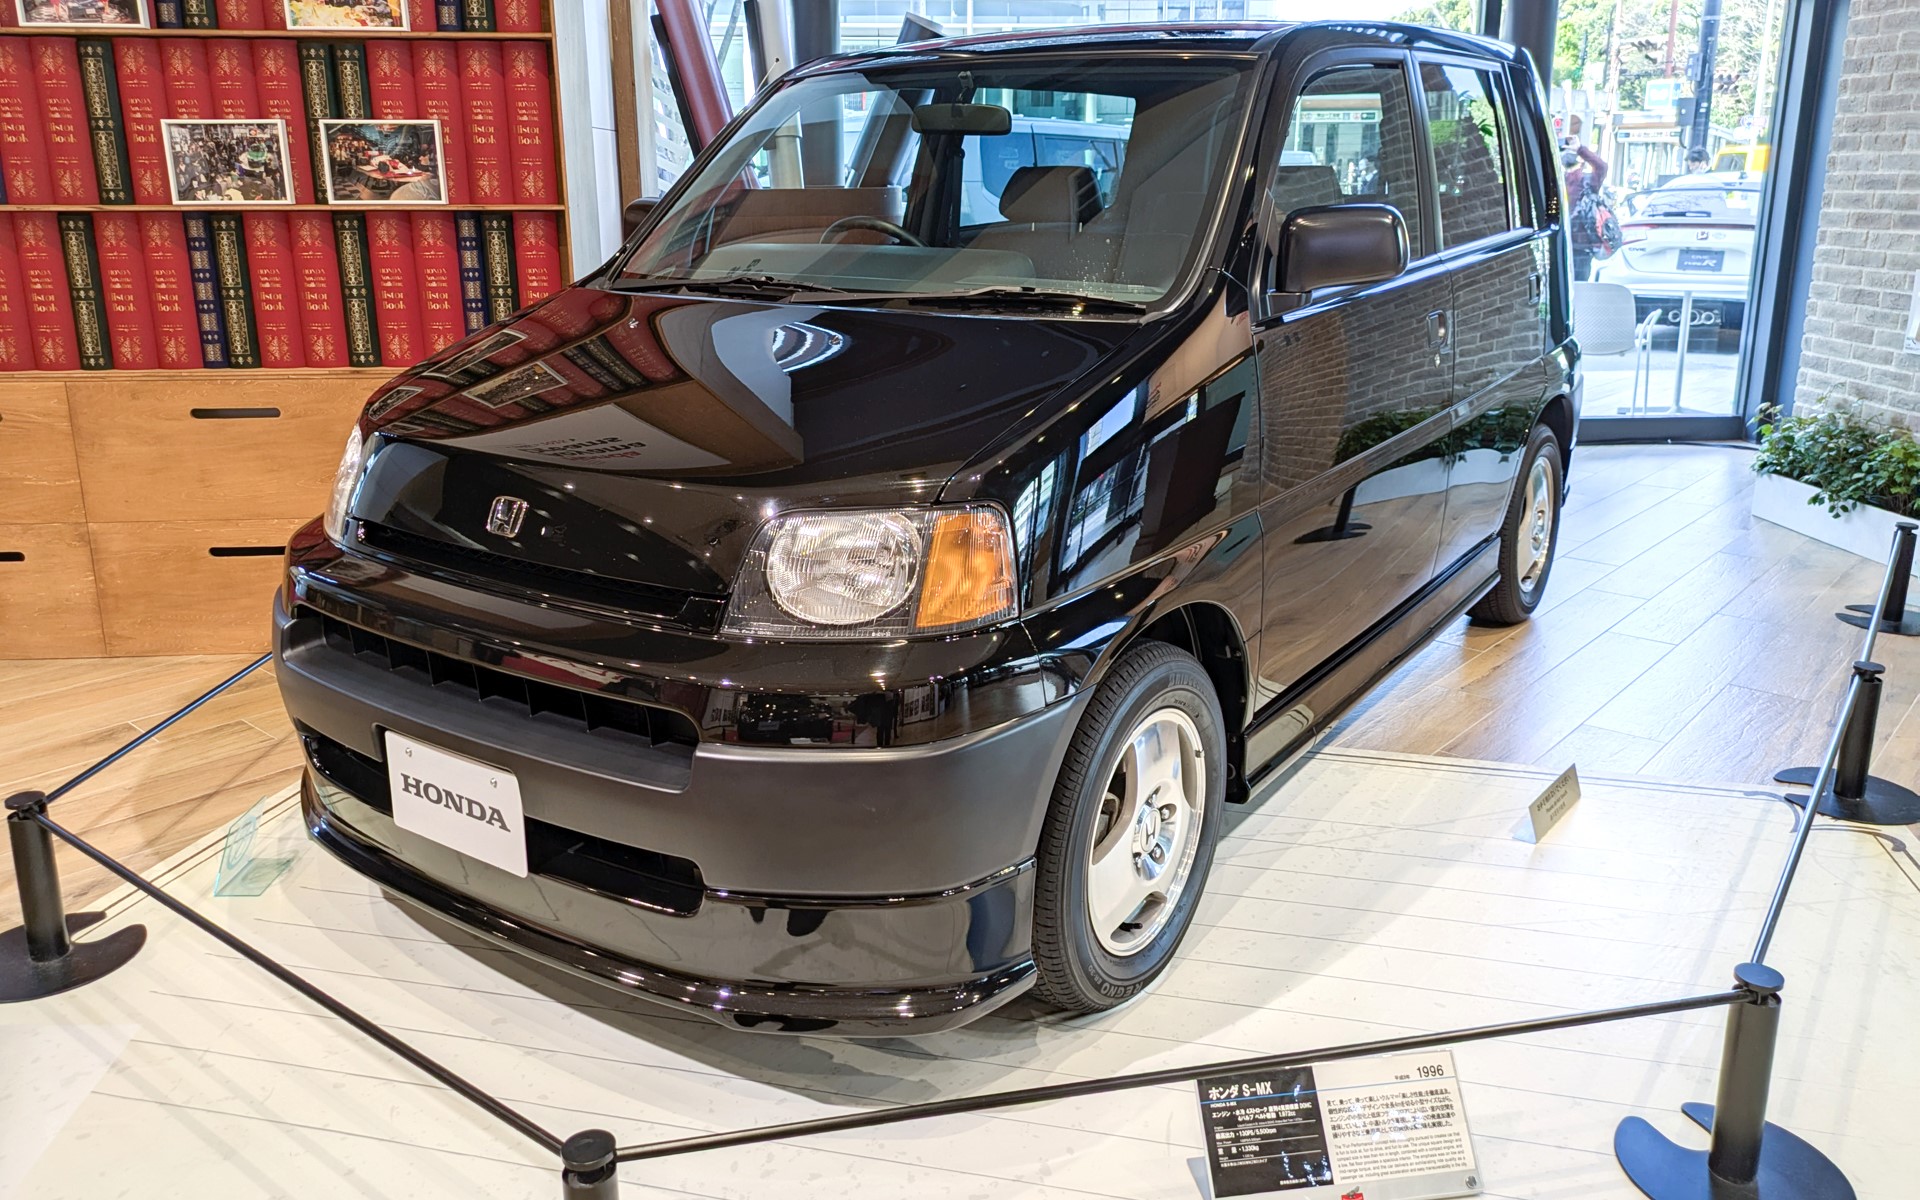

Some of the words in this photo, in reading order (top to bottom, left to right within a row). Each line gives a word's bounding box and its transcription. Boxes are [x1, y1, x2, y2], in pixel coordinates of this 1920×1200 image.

[400, 773, 511, 832] HONDA
[1100, 982, 1143, 998] REGNO
[1416, 1064, 1444, 1078] 1996
[1208, 1085, 1240, 1100] ホンダ
[1242, 1081, 1273, 1096] S-MX
